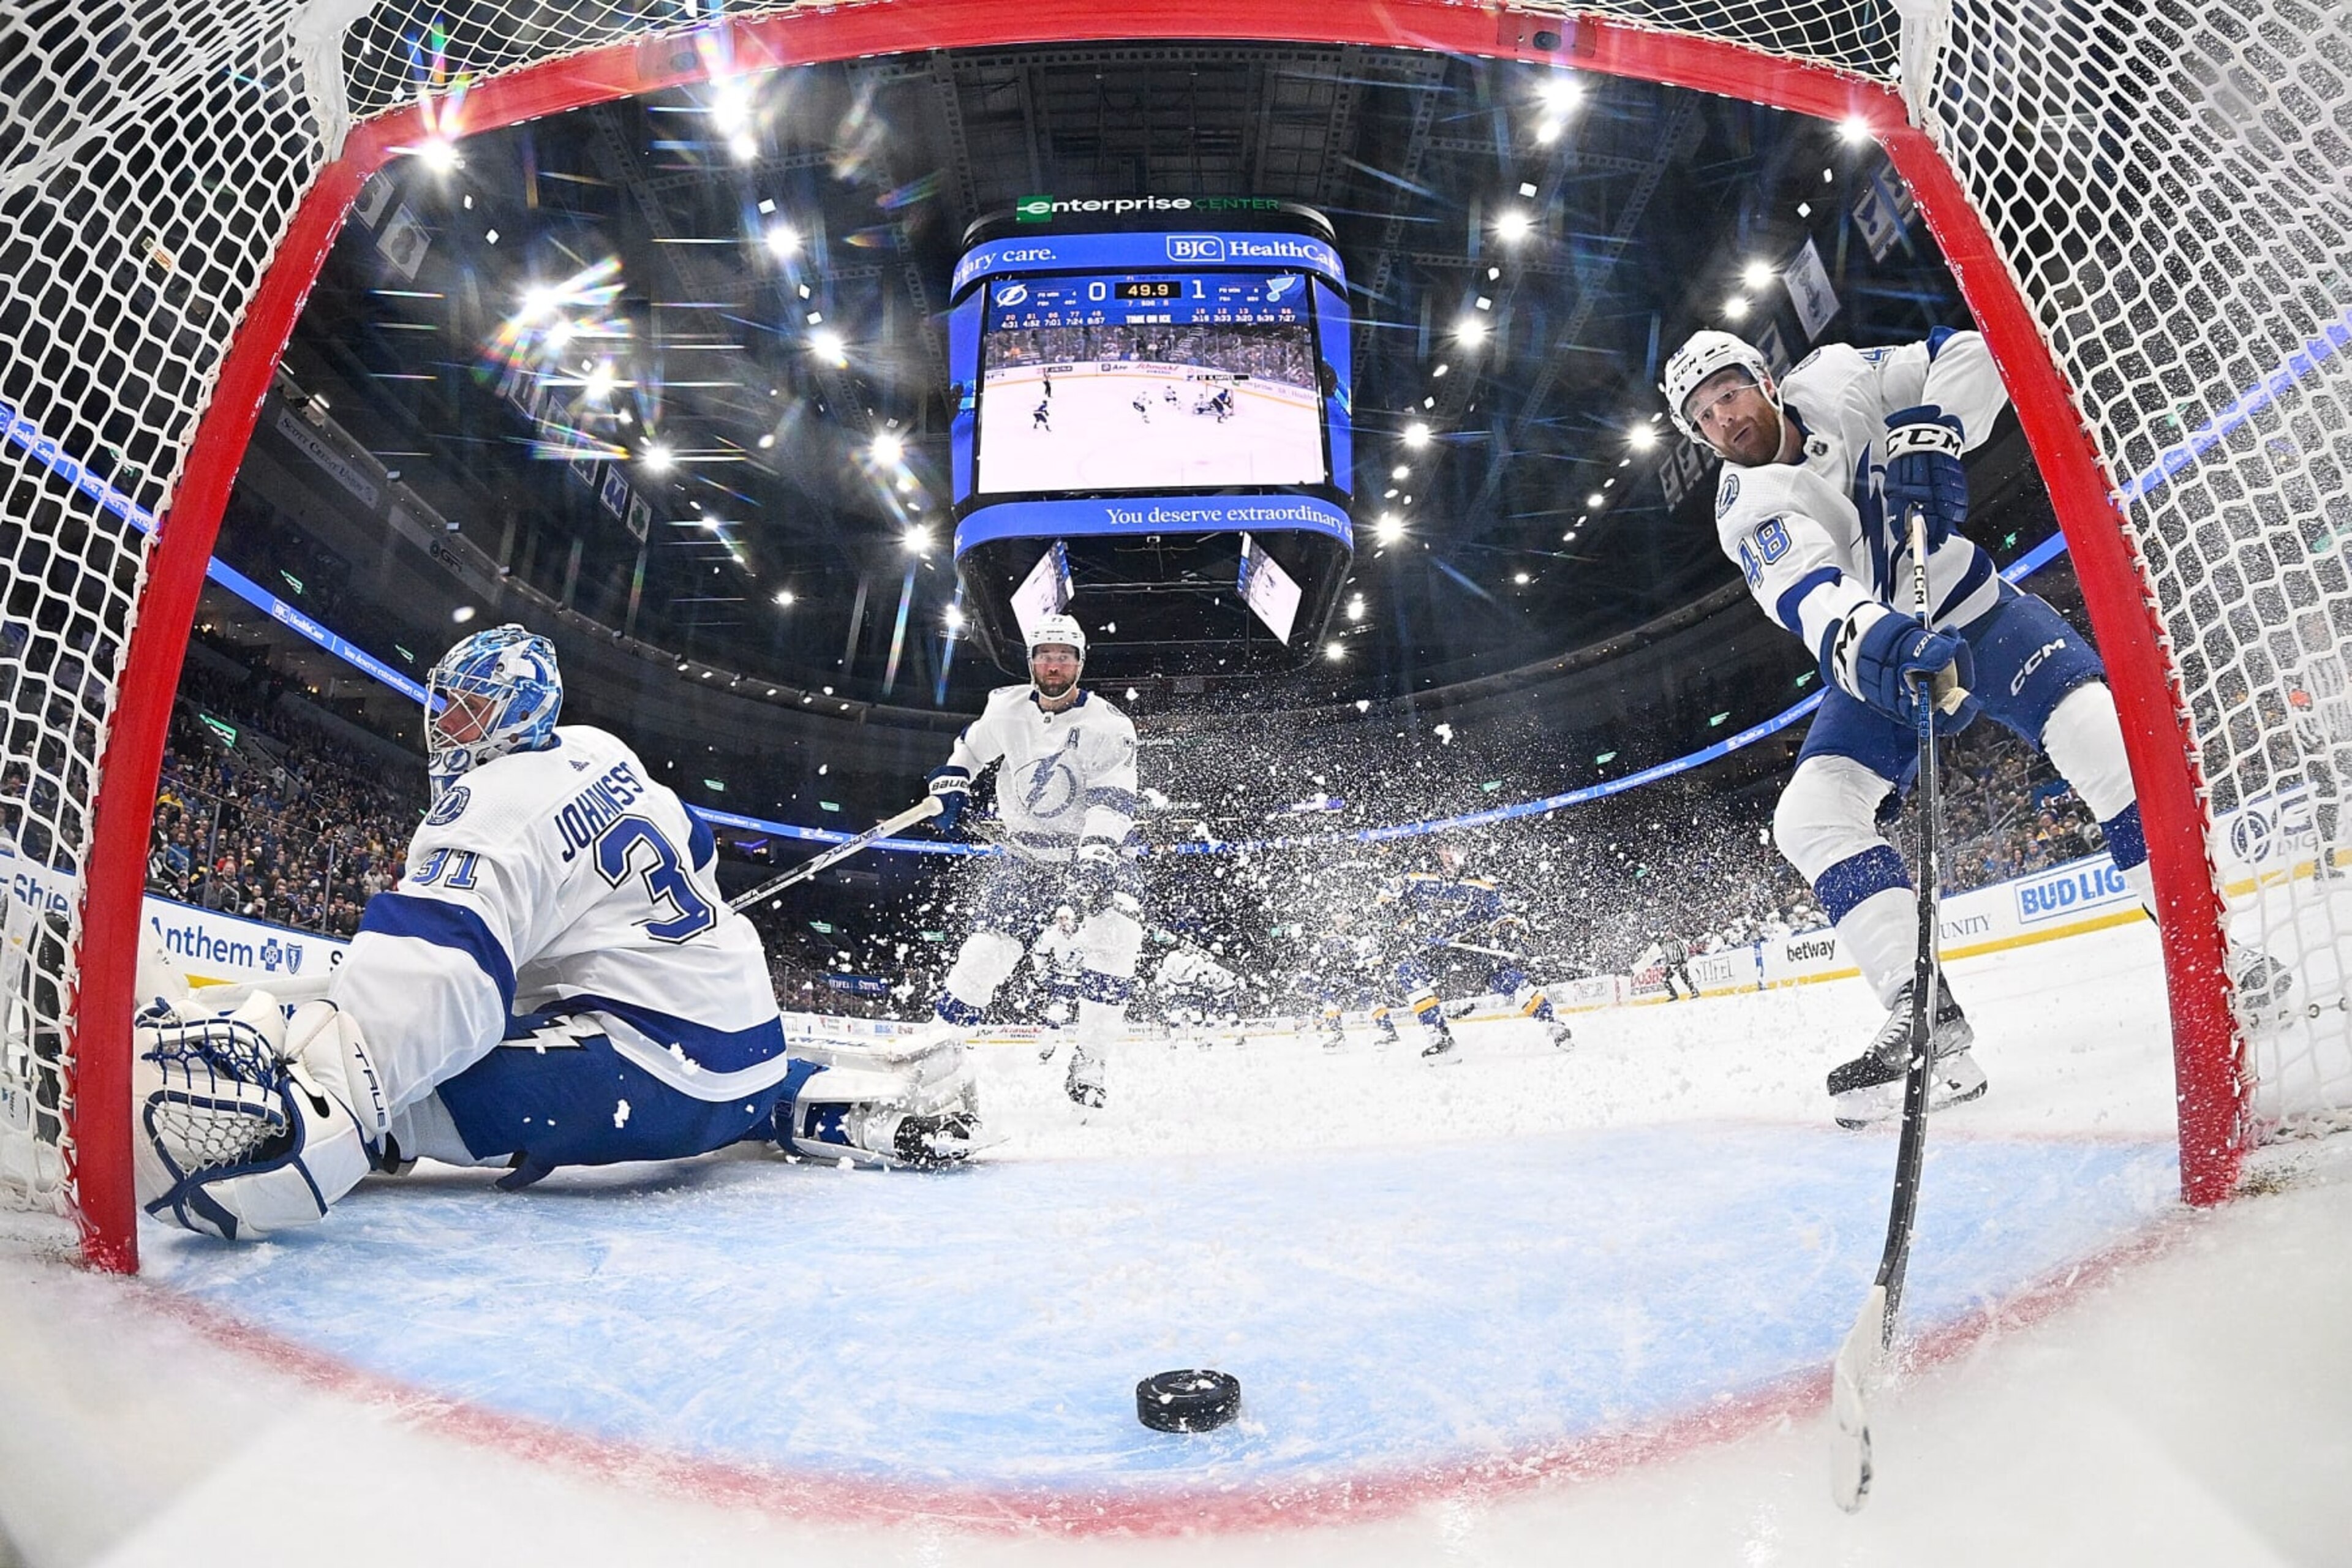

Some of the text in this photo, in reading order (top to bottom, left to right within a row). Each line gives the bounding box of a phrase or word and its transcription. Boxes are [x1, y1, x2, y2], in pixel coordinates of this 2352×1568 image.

[1017, 196, 1280, 214] enterprise CENTER
[1002, 247, 1057, 262] care.
[1175, 241, 1217, 257] BJC
[1089, 282, 1106, 301] 0
[1128, 284, 1169, 296] 49.9
[1192, 280, 1206, 298] 1
[1673, 357, 1697, 382] CCM
[1886, 428, 1961, 458] CCM
[1106, 508, 1144, 525] You
[1148, 507, 1222, 523] deserve
[1227, 505, 1343, 534] extraordinary
[1738, 516, 1792, 592] 48
[1914, 565, 1924, 605] CCM
[2010, 638, 2067, 697] CCM
[1918, 680, 1930, 738] ETSPEED
[1066, 726, 1080, 750] A
[554, 761, 646, 862] JOHANSS
[593, 813, 717, 944] 3
[2021, 864, 2127, 916] BUD LIG
[1938, 915, 1991, 940] UNITY
[1786, 939, 1836, 962] betway
[354, 1041, 386, 1128] TRUE
